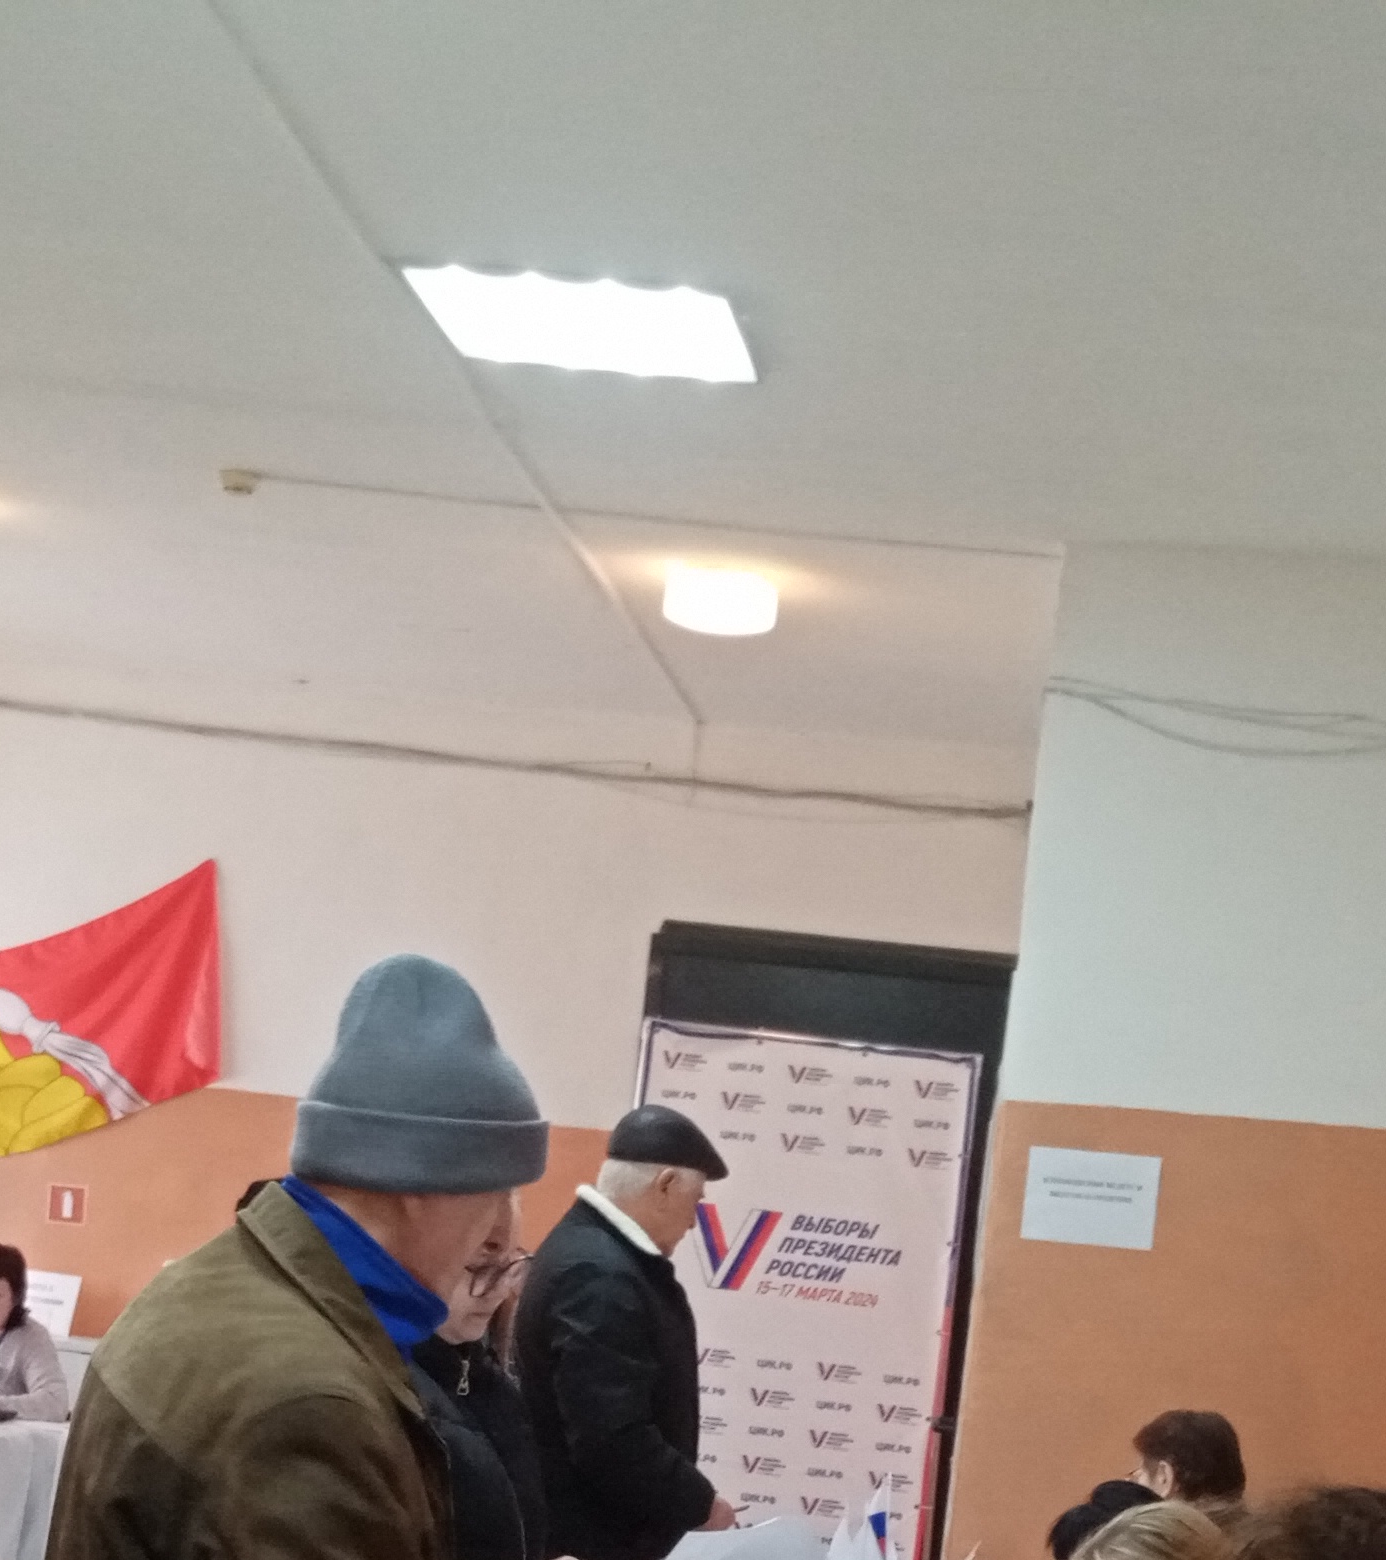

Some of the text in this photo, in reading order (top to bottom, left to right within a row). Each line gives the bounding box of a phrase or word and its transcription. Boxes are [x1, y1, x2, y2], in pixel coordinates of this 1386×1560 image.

[790, 1214, 880, 1240] ВЫБОРЫ
[777, 1237, 903, 1267] ПРЕЗИДЕНТА
[765, 1259, 847, 1284] РОССИИ
[794, 1286, 844, 1303] МАРТА
[844, 1291, 879, 1308] 2024
